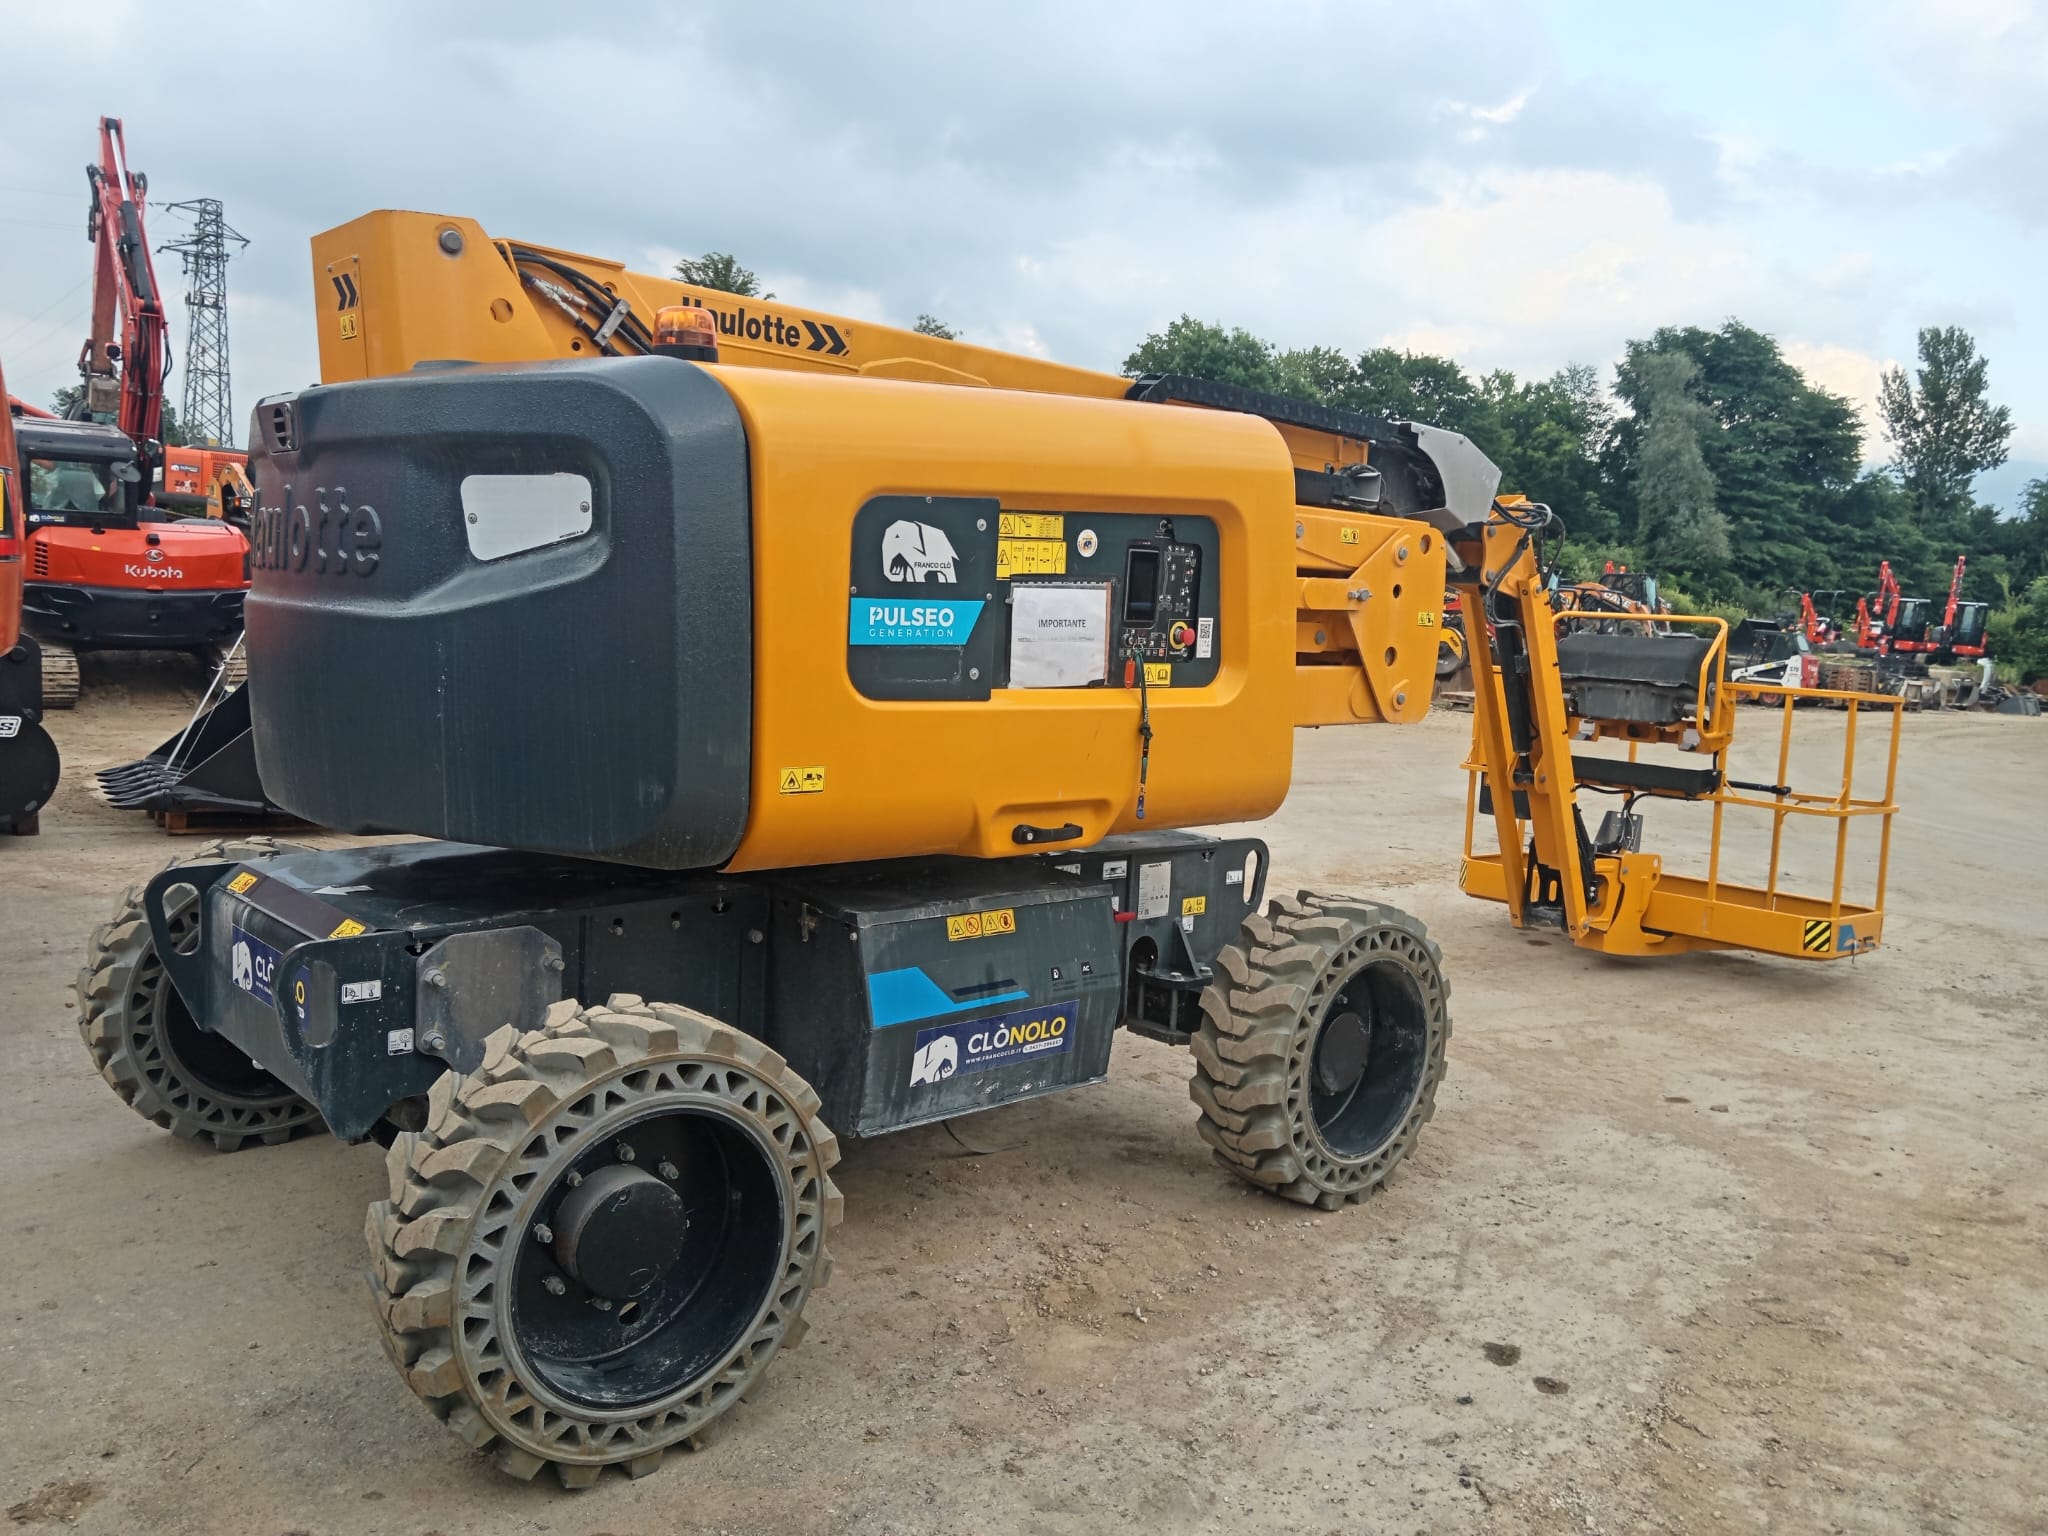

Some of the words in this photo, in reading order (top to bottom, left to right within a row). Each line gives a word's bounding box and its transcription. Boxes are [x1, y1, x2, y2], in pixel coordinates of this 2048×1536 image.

[914, 561, 939, 569] FRANCO
[124, 563, 184, 580] Kubota
[868, 606, 955, 628] PULSEO
[1038, 618, 1087, 628] IMPORTANTE
[868, 628, 954, 638] GENERATION
